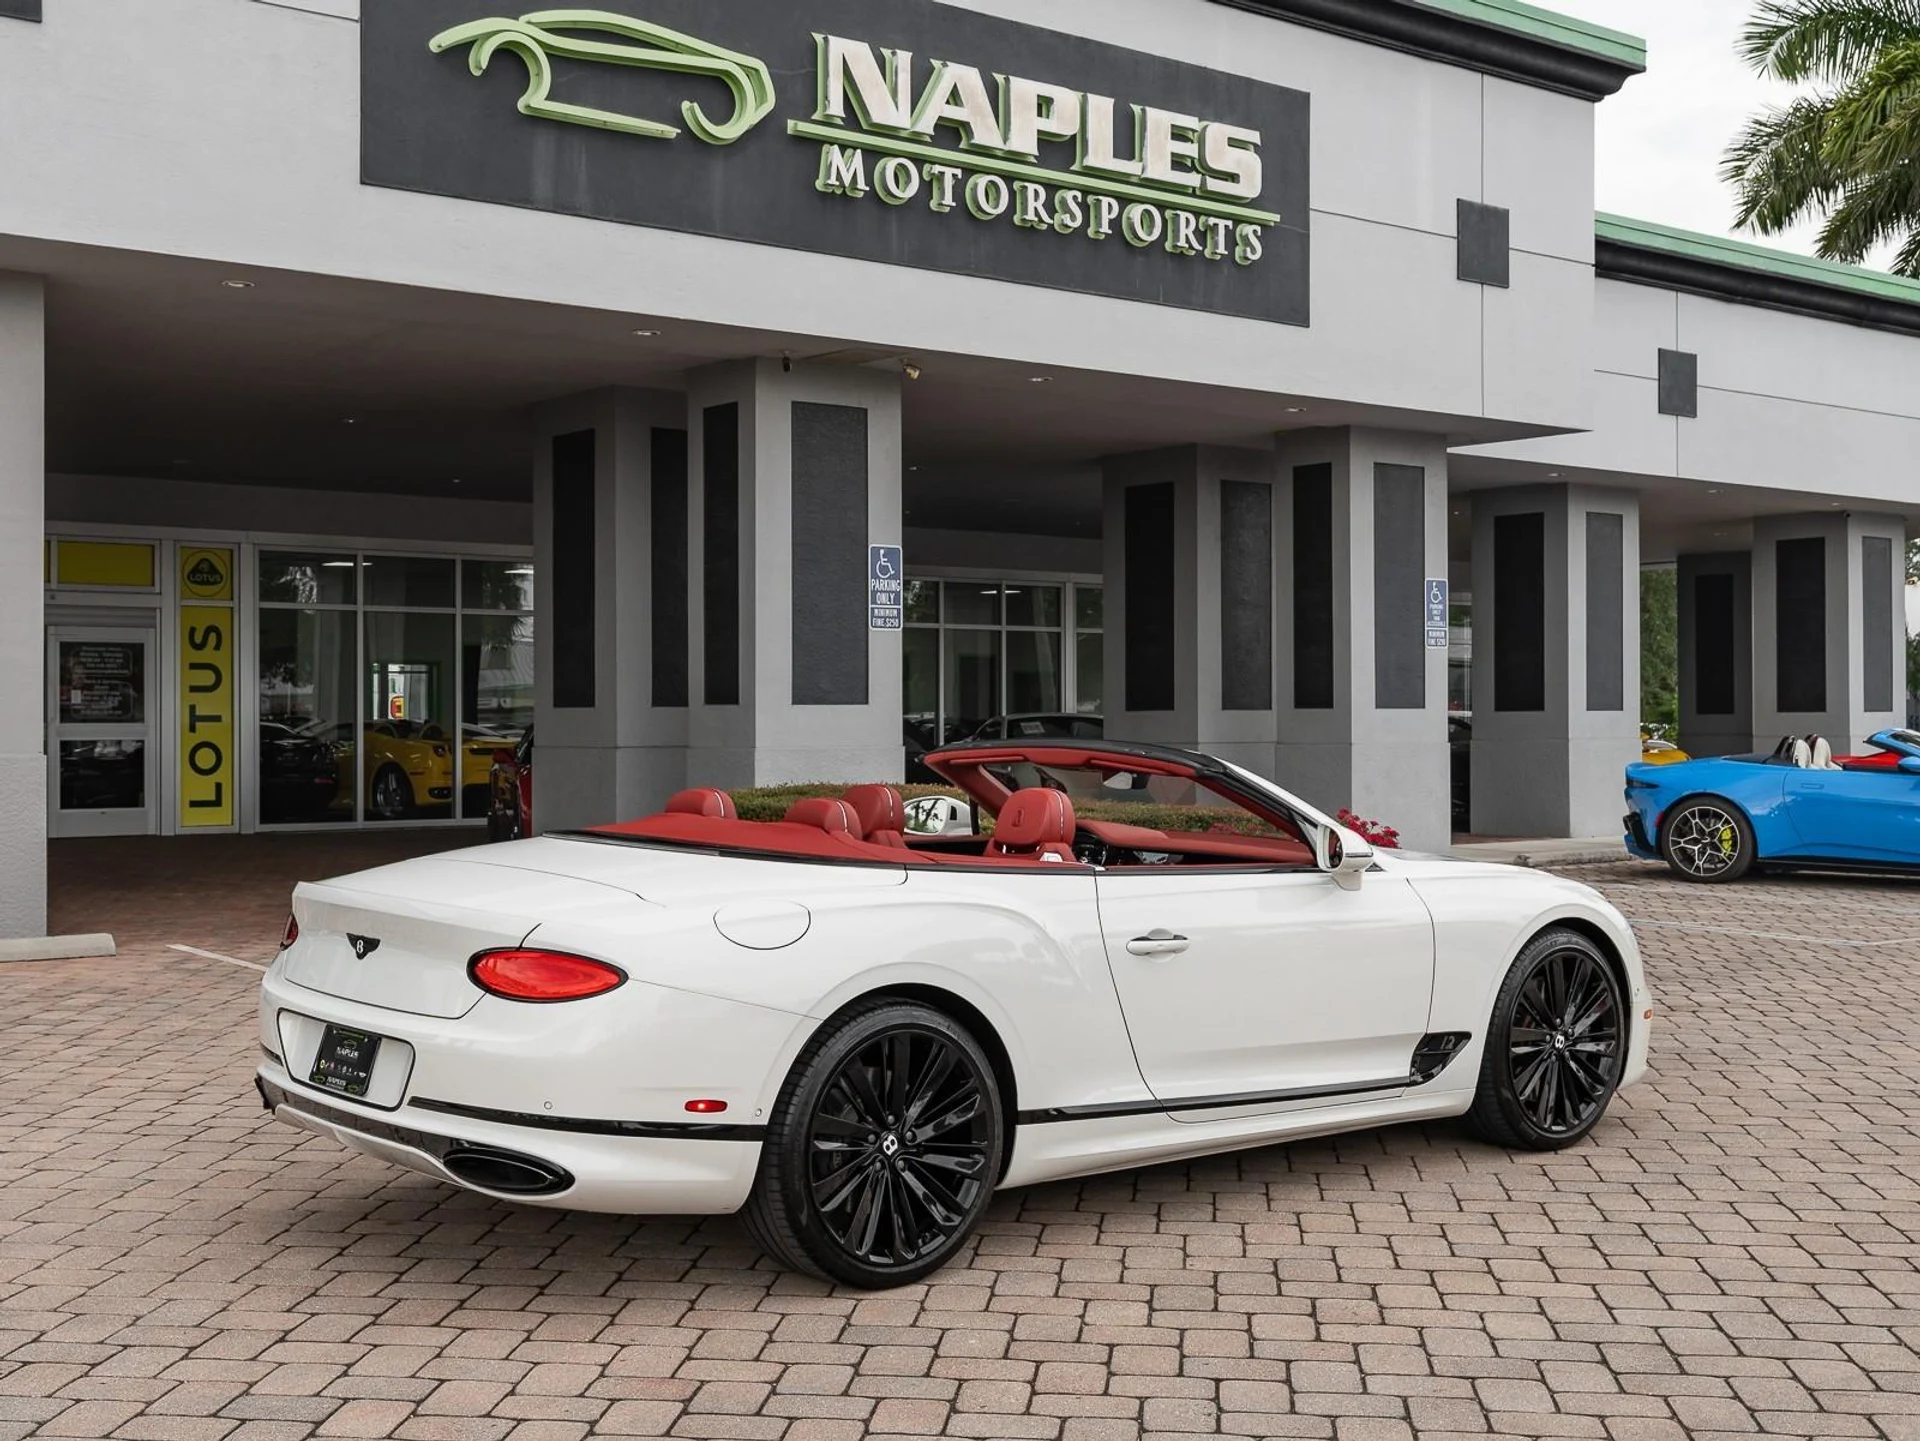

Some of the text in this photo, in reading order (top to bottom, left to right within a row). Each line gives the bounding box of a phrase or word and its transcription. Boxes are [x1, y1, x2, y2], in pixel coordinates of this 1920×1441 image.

[811, 31, 1263, 202] NAPLES
[815, 143, 1263, 265] MOTORSPORTS
[189, 572, 221, 583] LOTUS
[871, 579, 900, 591] PARKING
[876, 593, 894, 604] ONLY
[188, 624, 223, 808] LOTUS
[1440, 1035, 1456, 1050] 12
